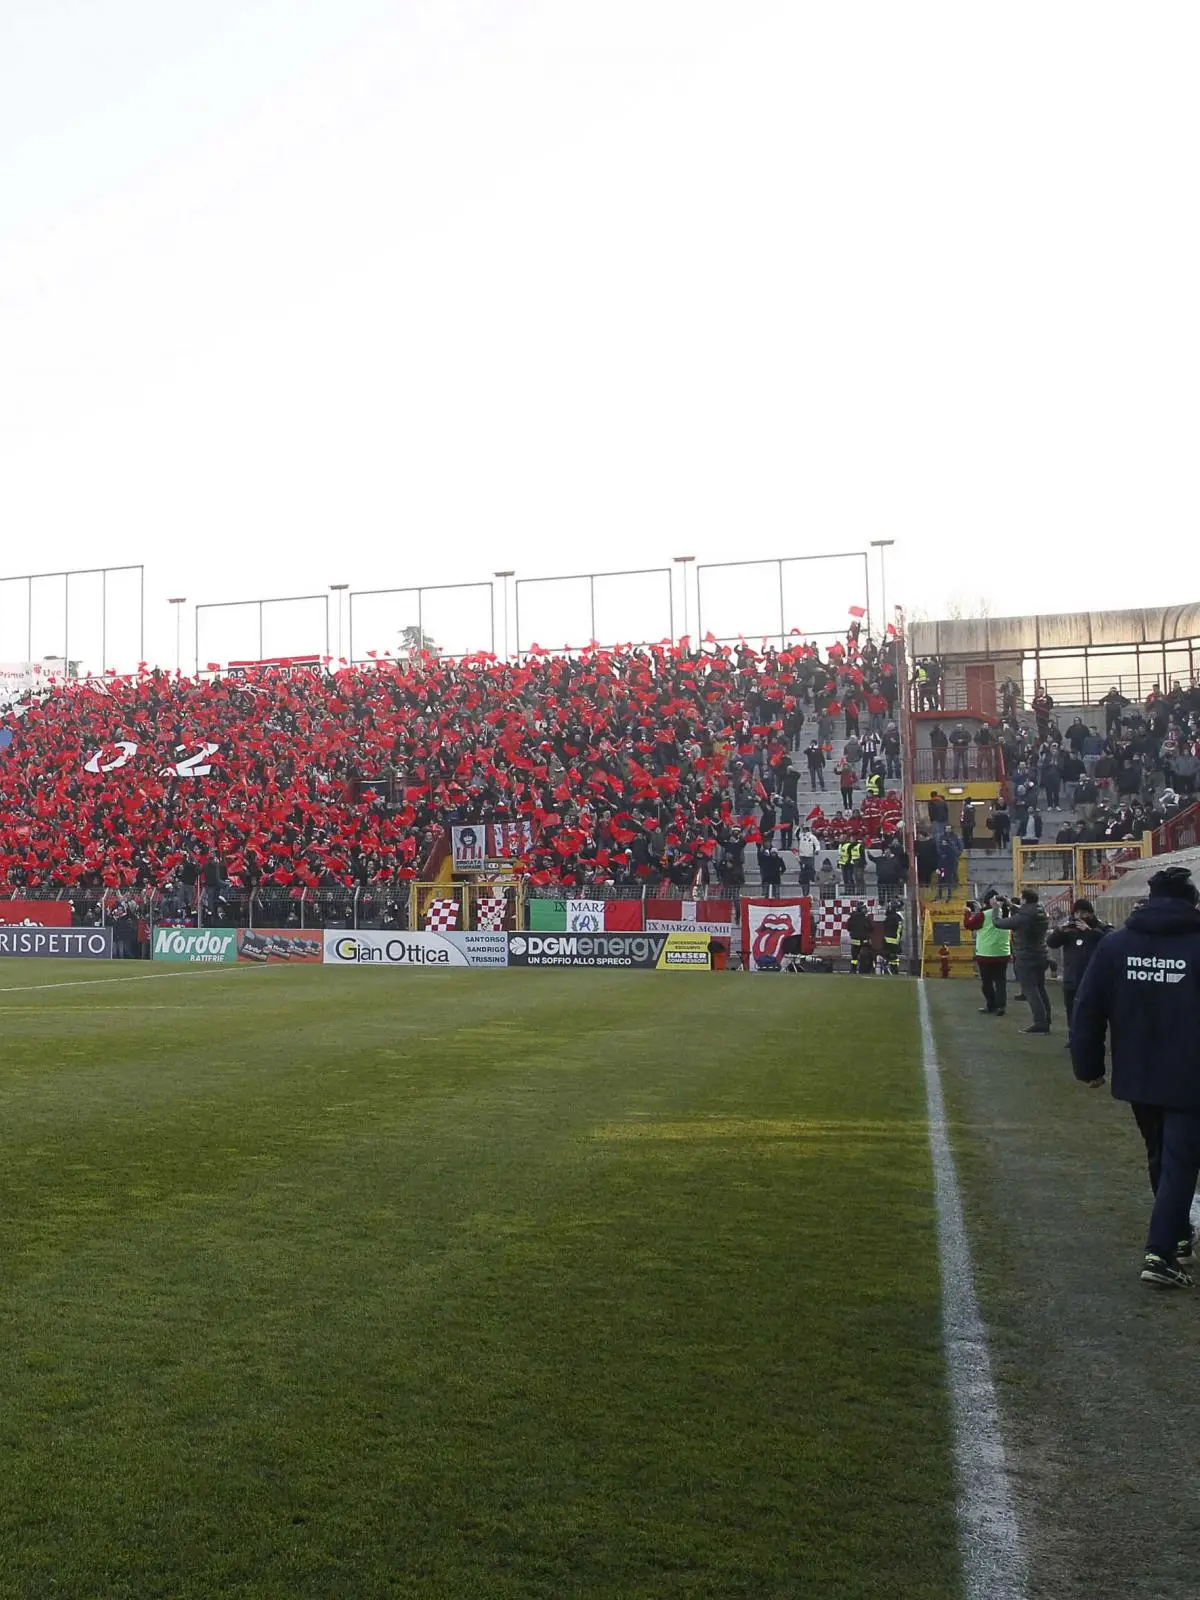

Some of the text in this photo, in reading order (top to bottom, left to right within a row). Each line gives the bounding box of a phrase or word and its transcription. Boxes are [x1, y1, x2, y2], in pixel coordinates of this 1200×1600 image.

[554, 901, 567, 912] IX
[661, 922, 696, 932] MARZO
[155, 929, 234, 954] Nordor
[335, 937, 450, 965] Gian Ottica
[541, 957, 571, 965] SOFFIO
[572, 957, 595, 965] ALLO
[596, 957, 632, 965] SPRECO
[1127, 956, 1186, 969] metano
[1127, 969, 1164, 982] nord
